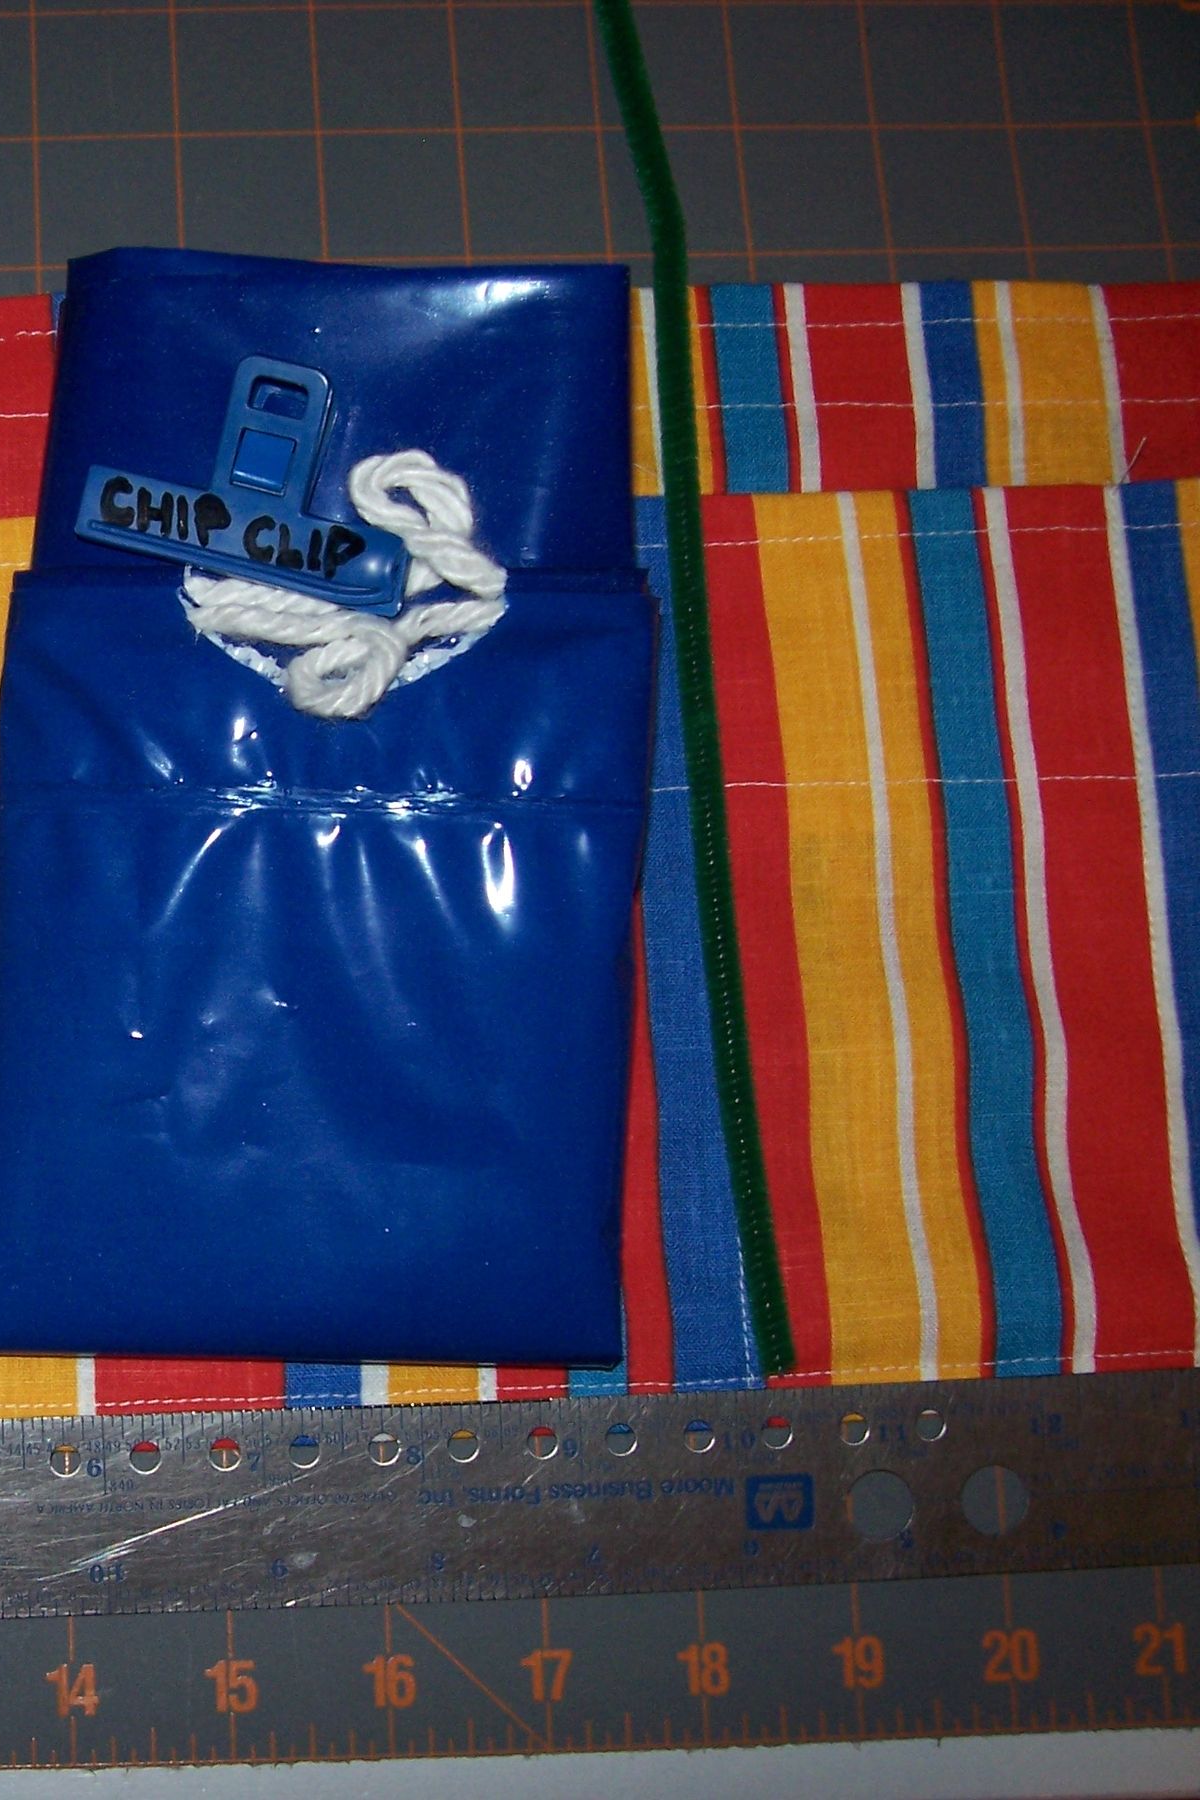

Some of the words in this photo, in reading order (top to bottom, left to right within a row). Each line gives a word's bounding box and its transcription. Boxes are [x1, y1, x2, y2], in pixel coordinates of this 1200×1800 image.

[100, 476, 231, 547] CHIP
[243, 516, 366, 579] CLIP
[86, 1457, 103, 1478] 6
[246, 1451, 261, 1472] 7
[405, 1445, 422, 1466] 8
[562, 1437, 579, 1459] 9
[549, 1479, 651, 1501] Business
[661, 1475, 736, 1497] Moore
[45, 1663, 99, 1716] 14
[204, 1660, 258, 1713] 15
[362, 1654, 417, 1708] 16
[520, 1649, 573, 1701] 17
[676, 1643, 730, 1696] 18
[832, 1635, 885, 1689] 19
[982, 1629, 1039, 1682] 20
[1133, 1622, 1187, 1677] 21
